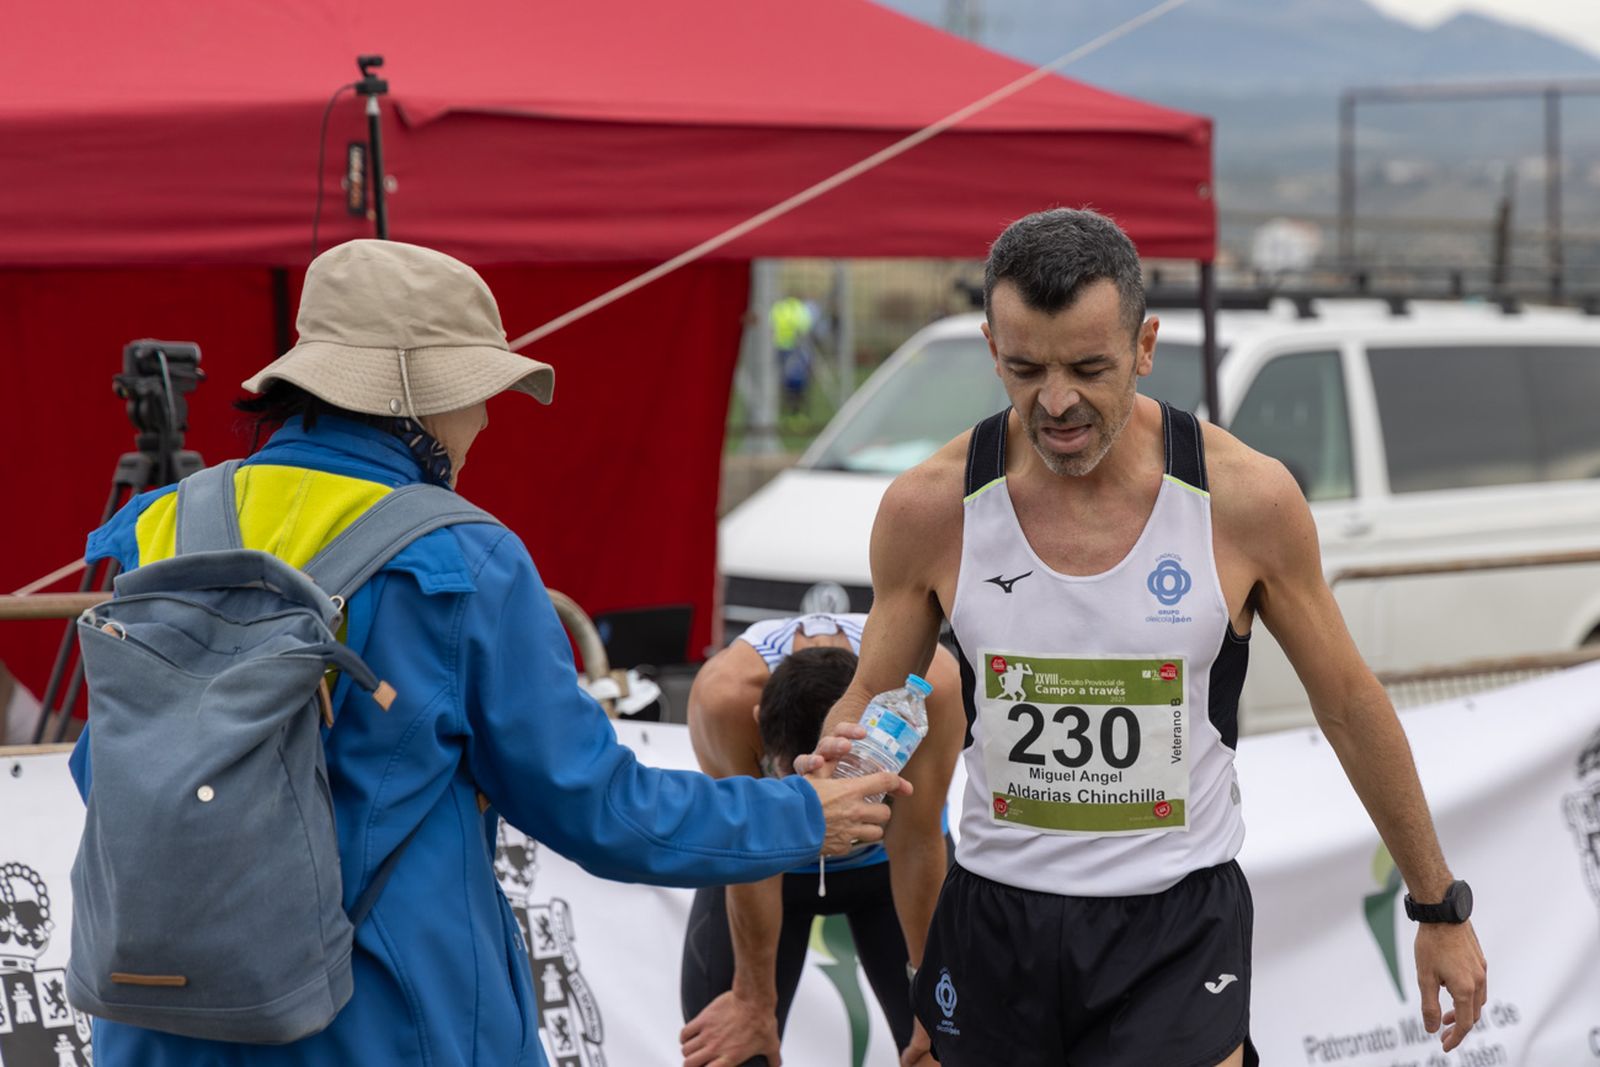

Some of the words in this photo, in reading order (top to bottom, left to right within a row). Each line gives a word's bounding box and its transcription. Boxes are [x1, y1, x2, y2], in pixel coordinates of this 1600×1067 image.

[1035, 673, 1059, 685] XXVIII
[1059, 678, 1084, 686] Circuito
[1084, 678, 1115, 686] Provincial
[1116, 679, 1125, 687] de
[1035, 685, 1076, 696] Campo
[1079, 687, 1086, 695] a
[1089, 686, 1126, 696] través
[1170, 697, 1181, 706] B
[1007, 703, 1141, 769] 230
[1170, 710, 1182, 765] Veterano
[1029, 767, 1076, 783] Miguel
[1080, 770, 1122, 785] Angel
[1007, 782, 1072, 803] Aldarias
[1077, 788, 1165, 804] Chinchilla
[1303, 1022, 1398, 1065] Patronato
